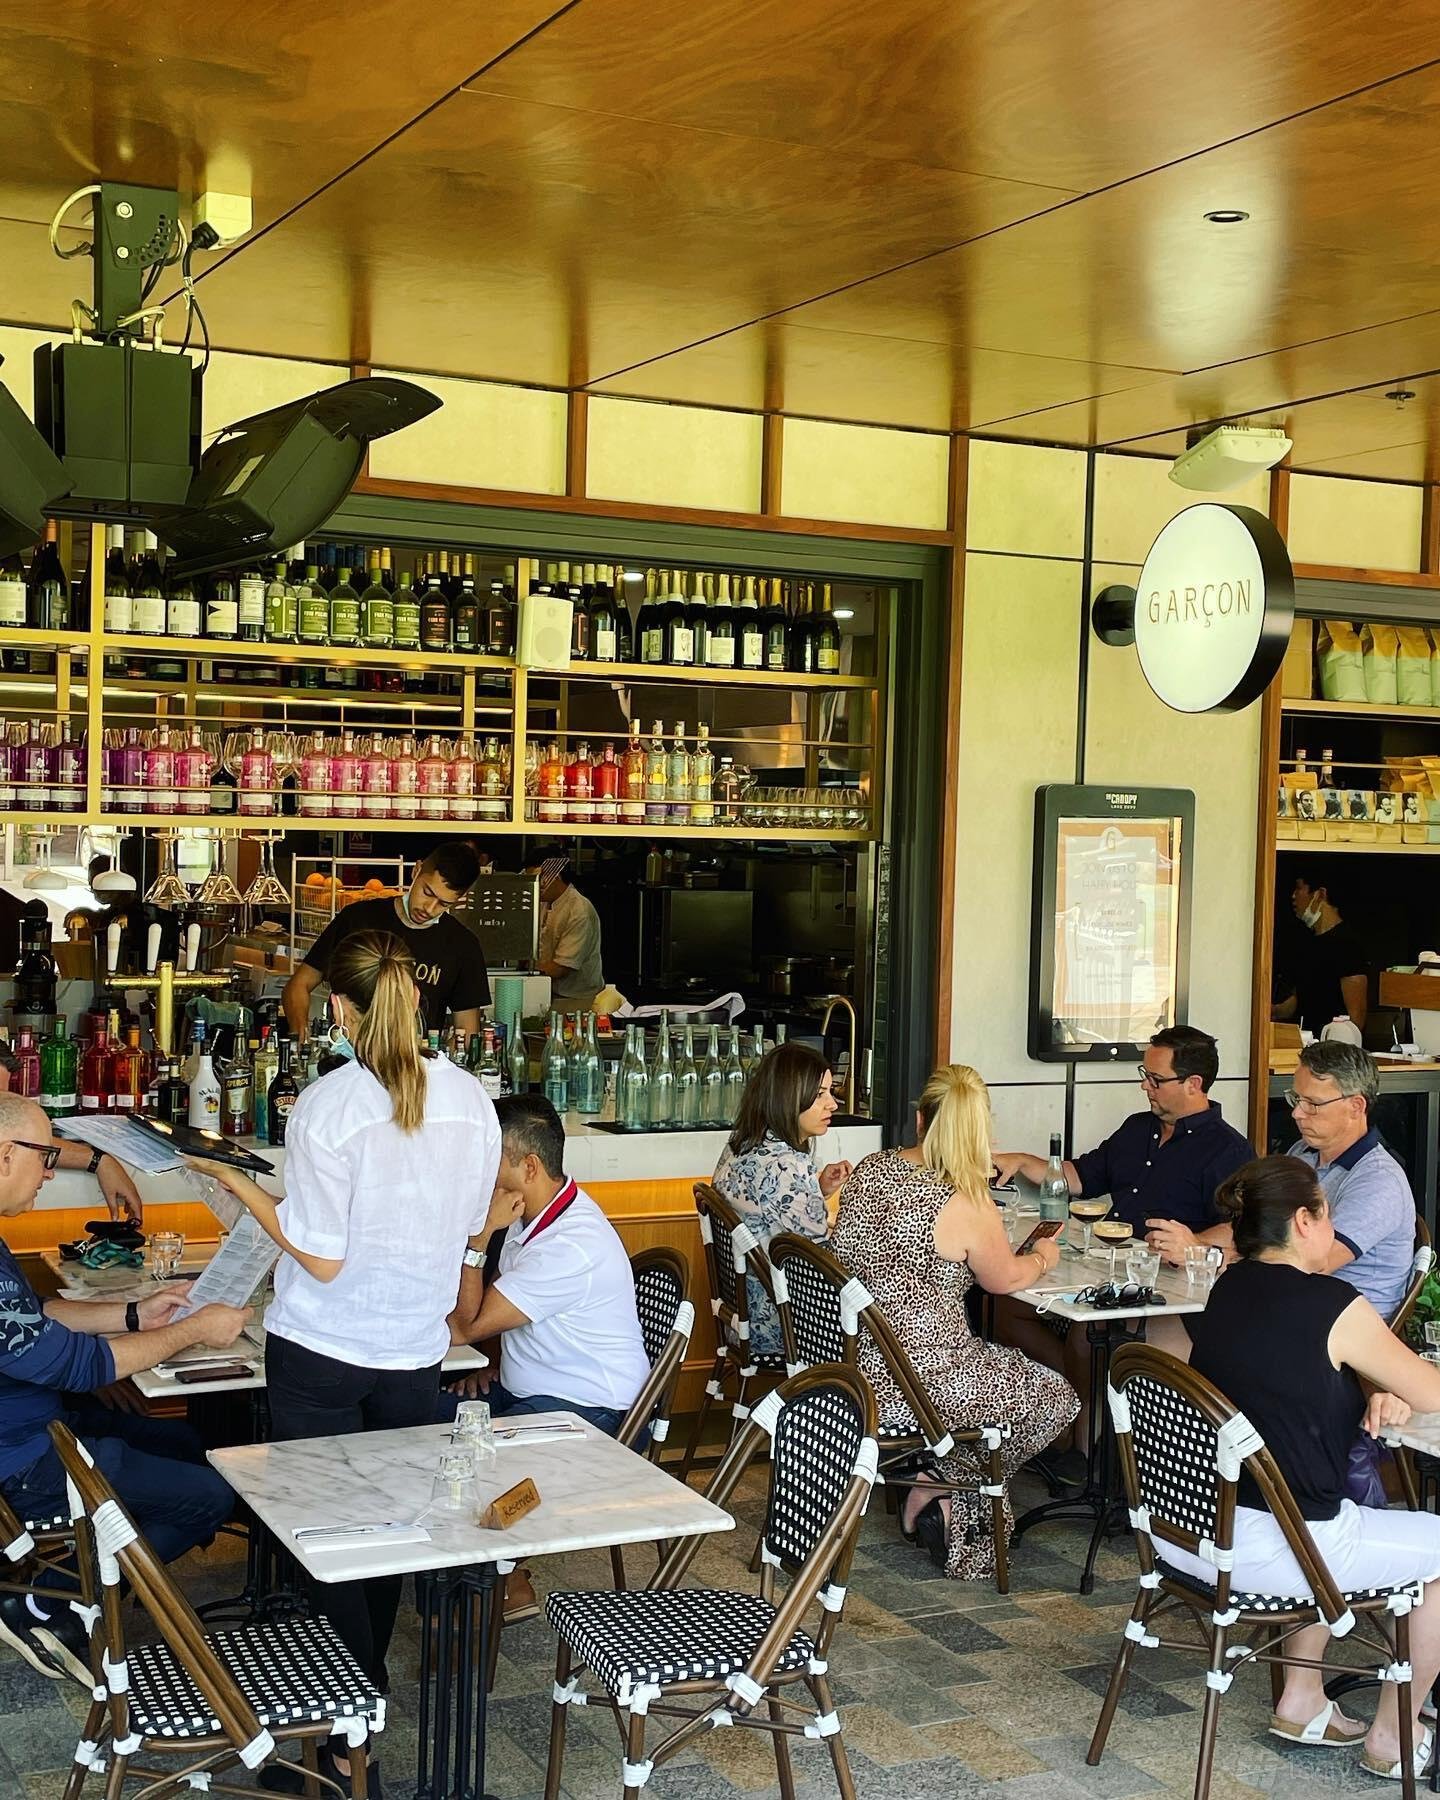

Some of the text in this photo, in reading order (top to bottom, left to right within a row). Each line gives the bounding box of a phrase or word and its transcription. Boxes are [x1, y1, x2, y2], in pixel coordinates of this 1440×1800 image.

[1149, 579, 1250, 628] GARÇON
[1111, 793, 1138, 805] CANOPY
[412, 961, 442, 986] ON
